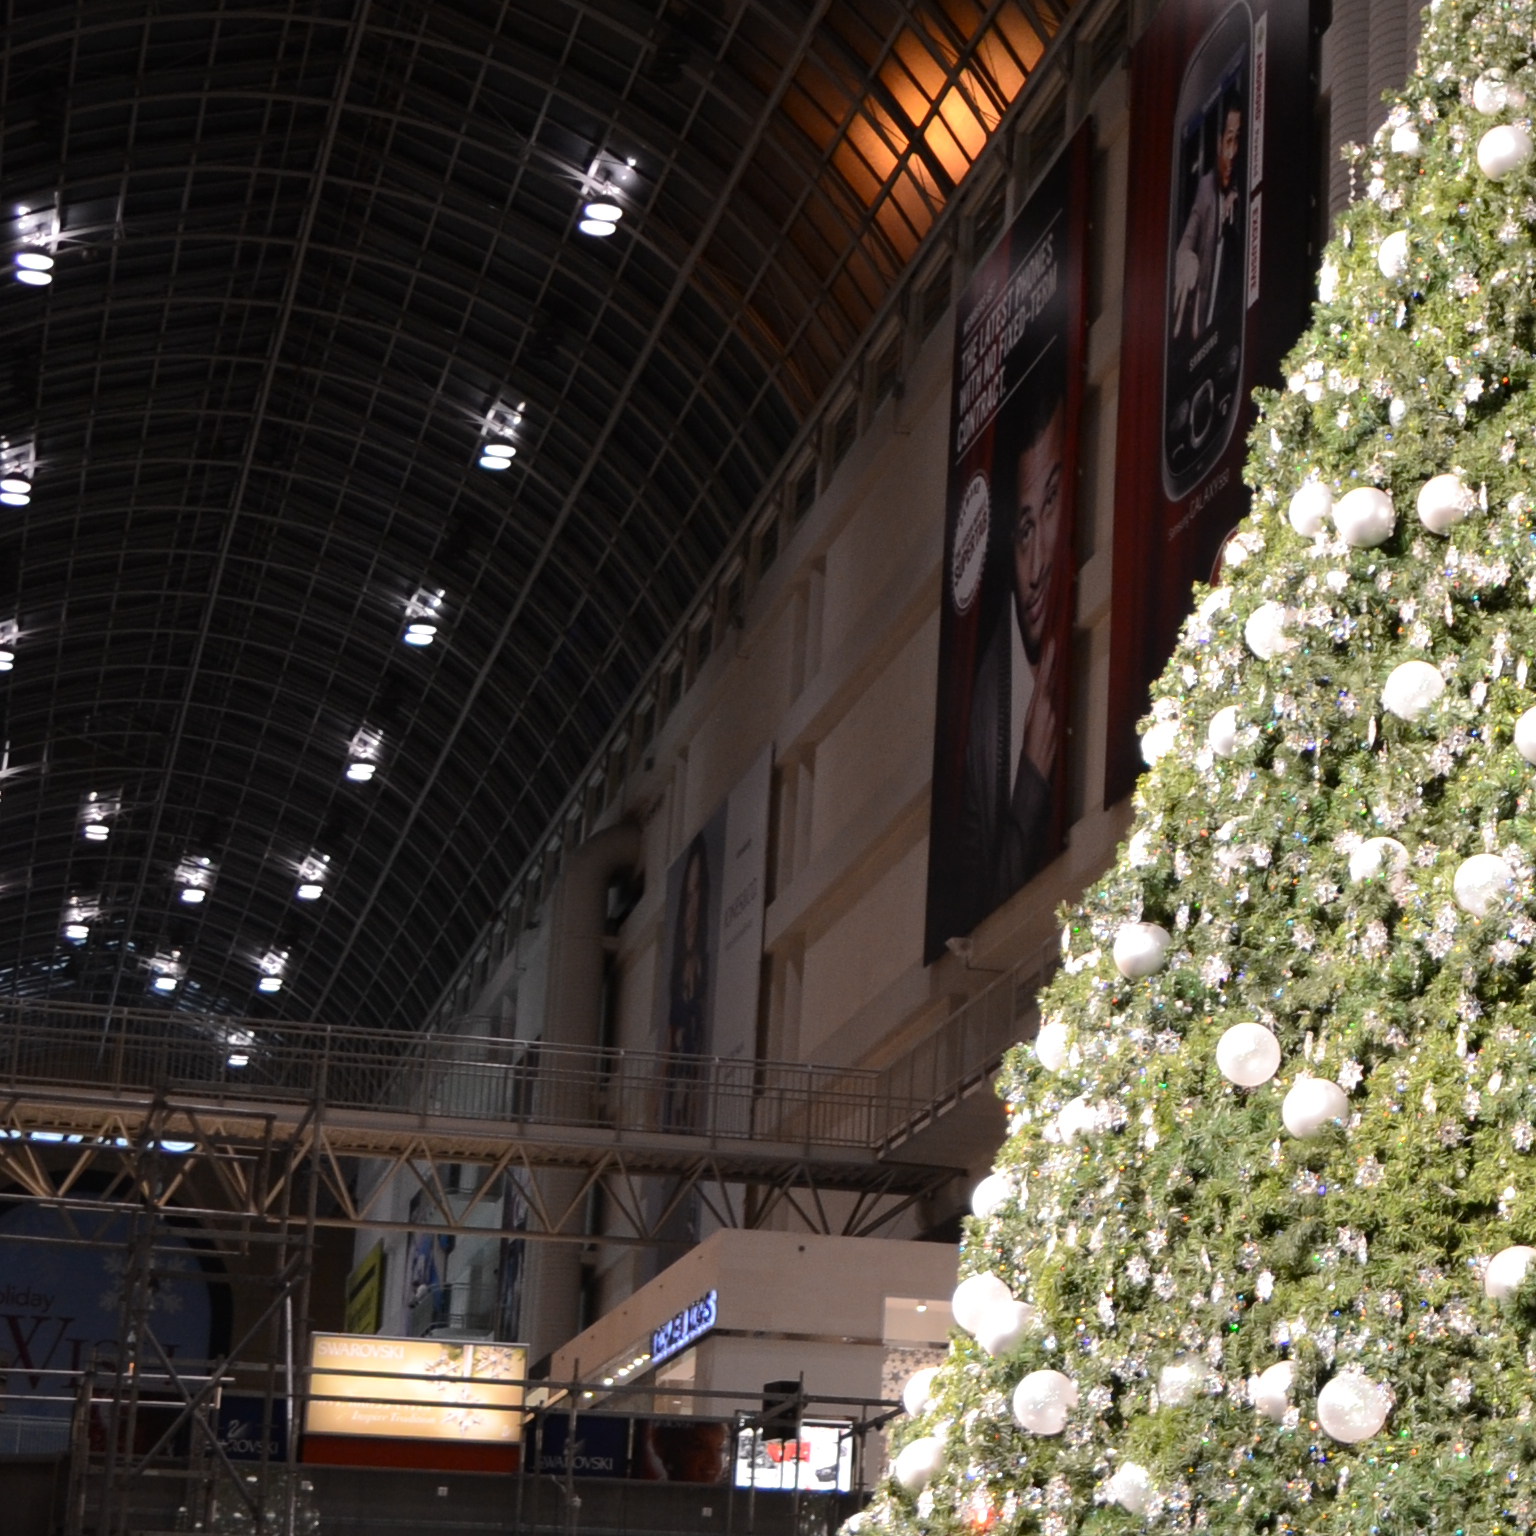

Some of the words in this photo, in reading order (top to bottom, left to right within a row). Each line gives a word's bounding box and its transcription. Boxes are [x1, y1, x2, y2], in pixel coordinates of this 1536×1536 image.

[960, 360, 983, 417] WITH
[982, 342, 999, 387] NO
[1000, 260, 1058, 359] FIXED-TERM
[962, 337, 979, 381] THE
[979, 286, 1014, 357] LATEST
[1013, 232, 1054, 310] PHONES
[1189, 330, 1219, 372] SAMSUNG
[316, 1341, 405, 1360] SWAROVSKI
